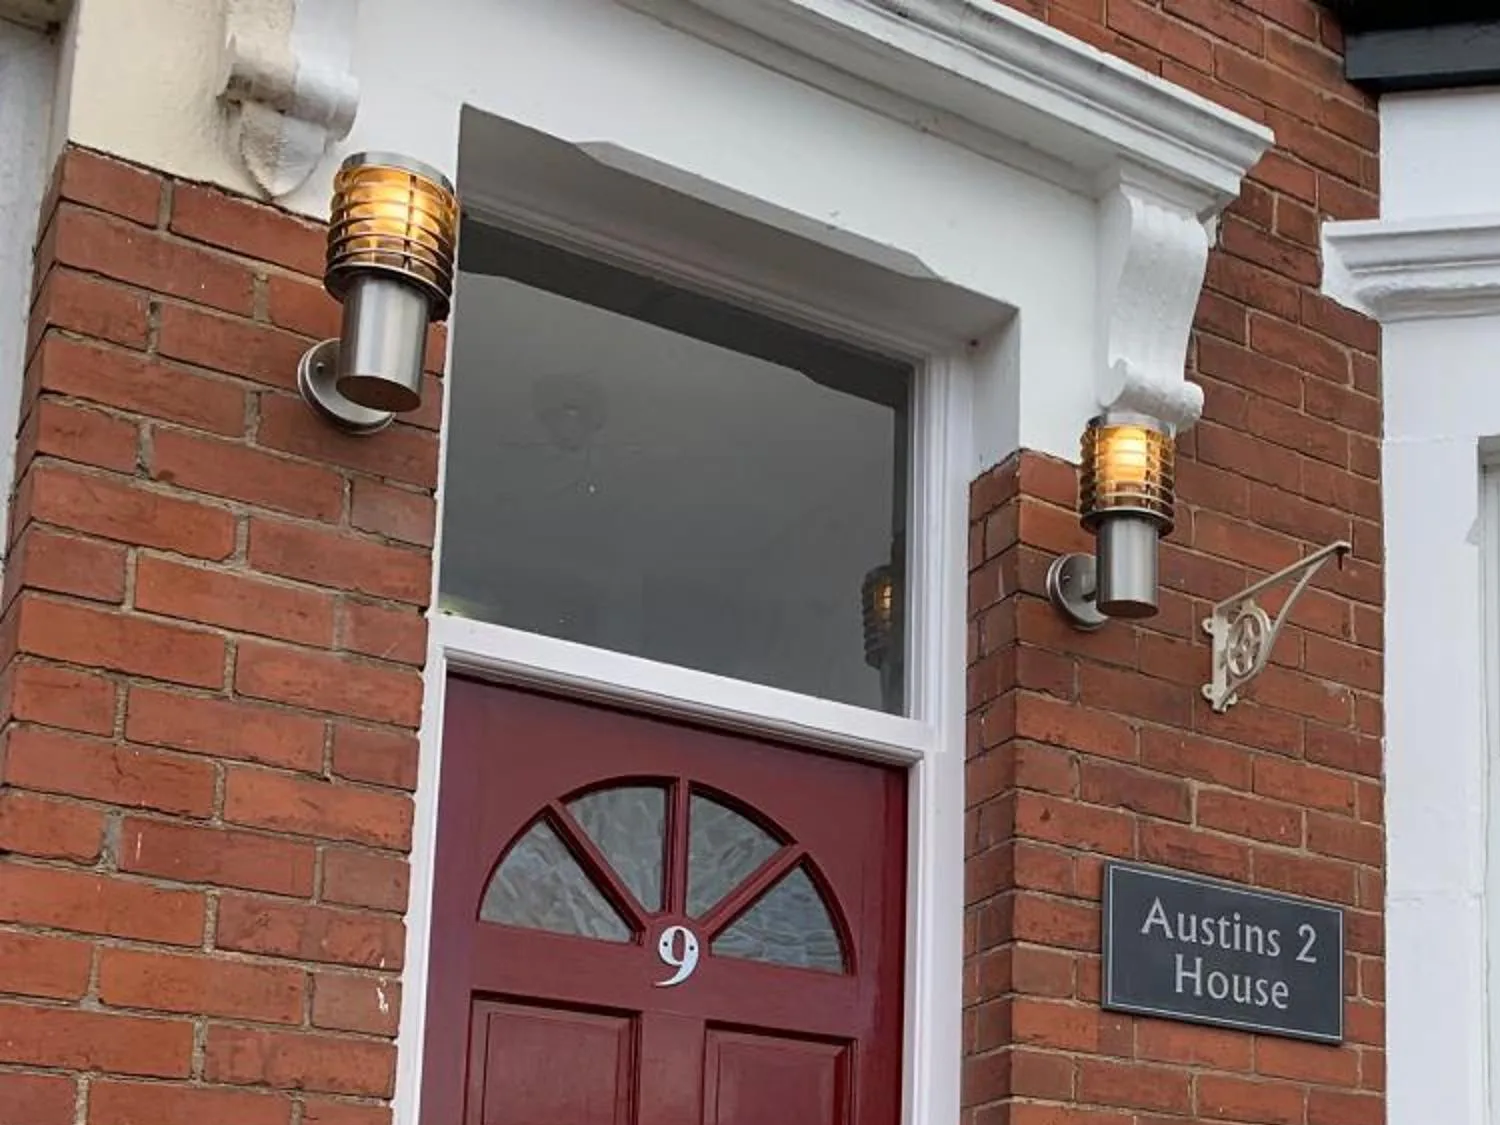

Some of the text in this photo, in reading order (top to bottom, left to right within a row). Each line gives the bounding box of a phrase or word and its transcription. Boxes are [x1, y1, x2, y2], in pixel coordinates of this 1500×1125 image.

[656, 925, 699, 987] 9
[1141, 896, 1317, 963] Austins 2
[1175, 953, 1289, 1009] House
